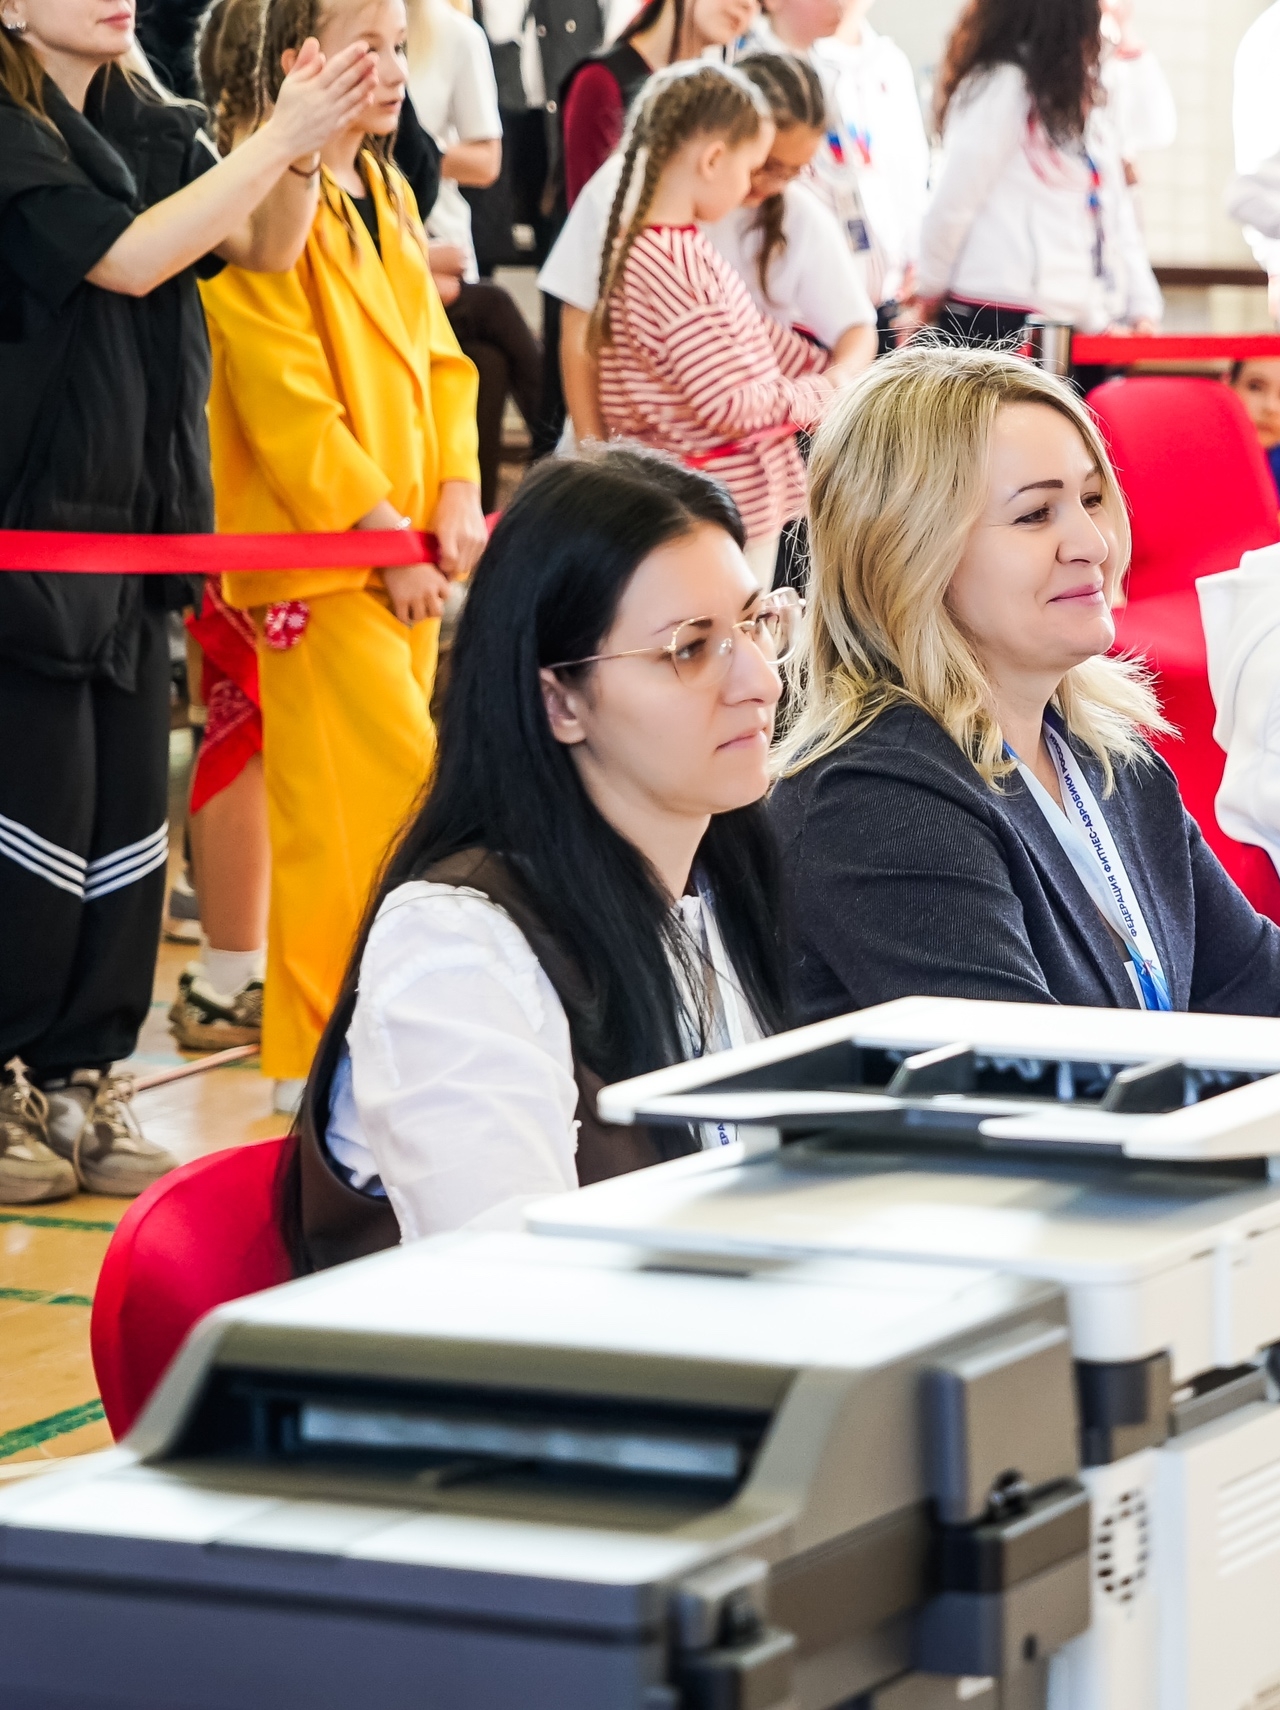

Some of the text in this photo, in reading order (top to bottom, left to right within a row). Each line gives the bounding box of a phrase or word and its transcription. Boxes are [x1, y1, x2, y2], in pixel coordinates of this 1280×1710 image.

[1049, 733, 1137, 937] ФЕДЕРАЦИЯ ФИТНЕС-АЭРОБИКИ РОССИИ
